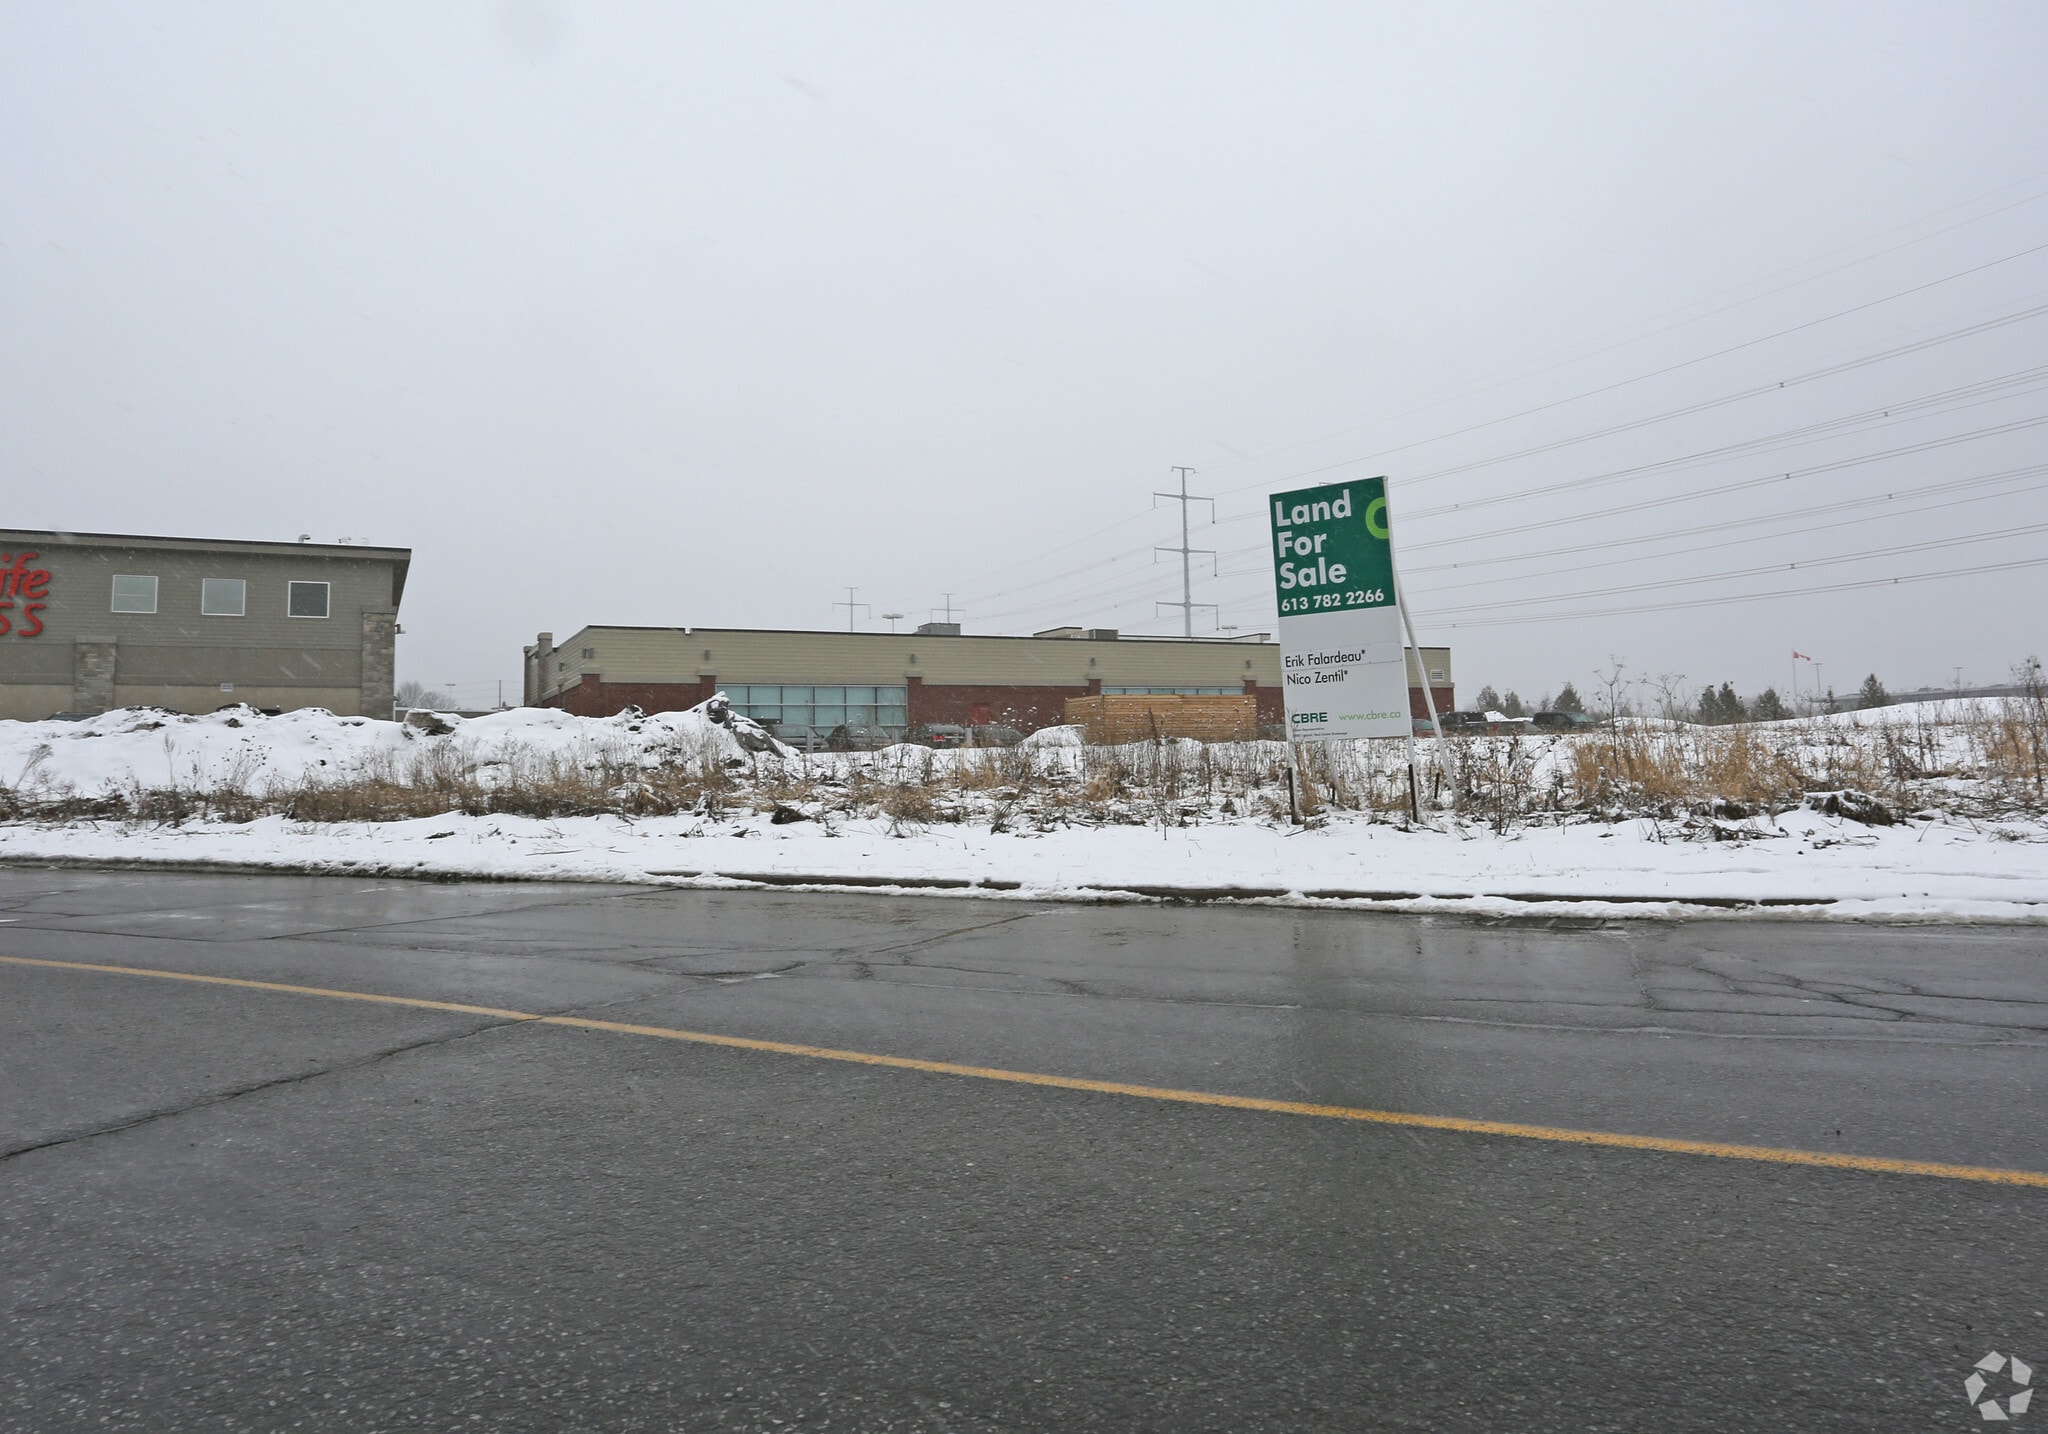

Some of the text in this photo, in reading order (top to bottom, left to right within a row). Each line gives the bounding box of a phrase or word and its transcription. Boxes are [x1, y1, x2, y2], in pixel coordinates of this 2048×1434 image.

[1275, 489, 1352, 527] Land
[1277, 531, 1327, 558] For
[1280, 557, 1347, 589] Sale
[1281, 589, 1384, 611] 613 782 2266
[1285, 655, 1305, 668] Erik
[1287, 674, 1312, 685] Nico
[1291, 712, 1328, 724] CBRE
